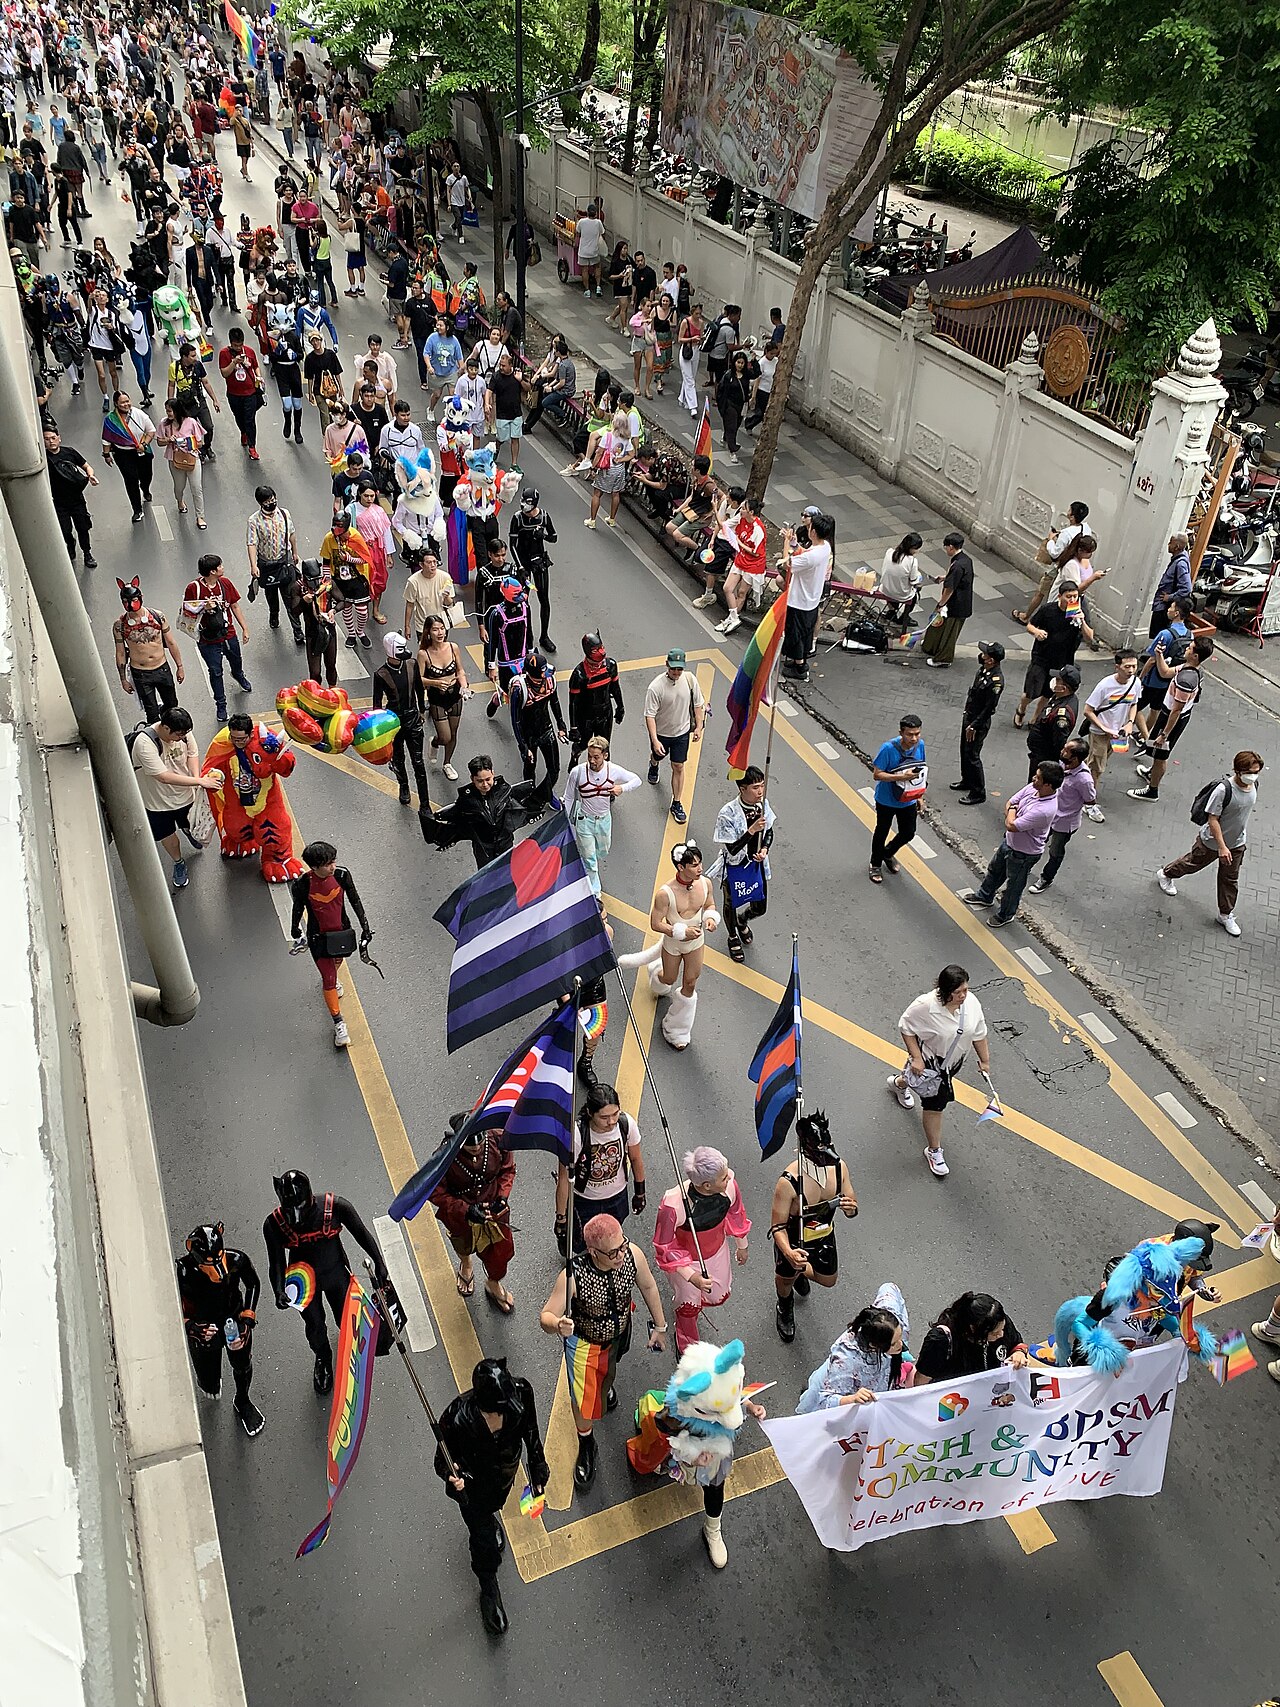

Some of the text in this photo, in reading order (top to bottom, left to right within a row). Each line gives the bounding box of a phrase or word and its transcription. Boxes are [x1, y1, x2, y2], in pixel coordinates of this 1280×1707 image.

[734, 881, 746, 890] Re
[738, 882, 759, 898] Move
[833, 1428, 976, 1470] FTISH
[990, 1424, 1029, 1451] &
[848, 1469, 1120, 1531] elebration of LVE
